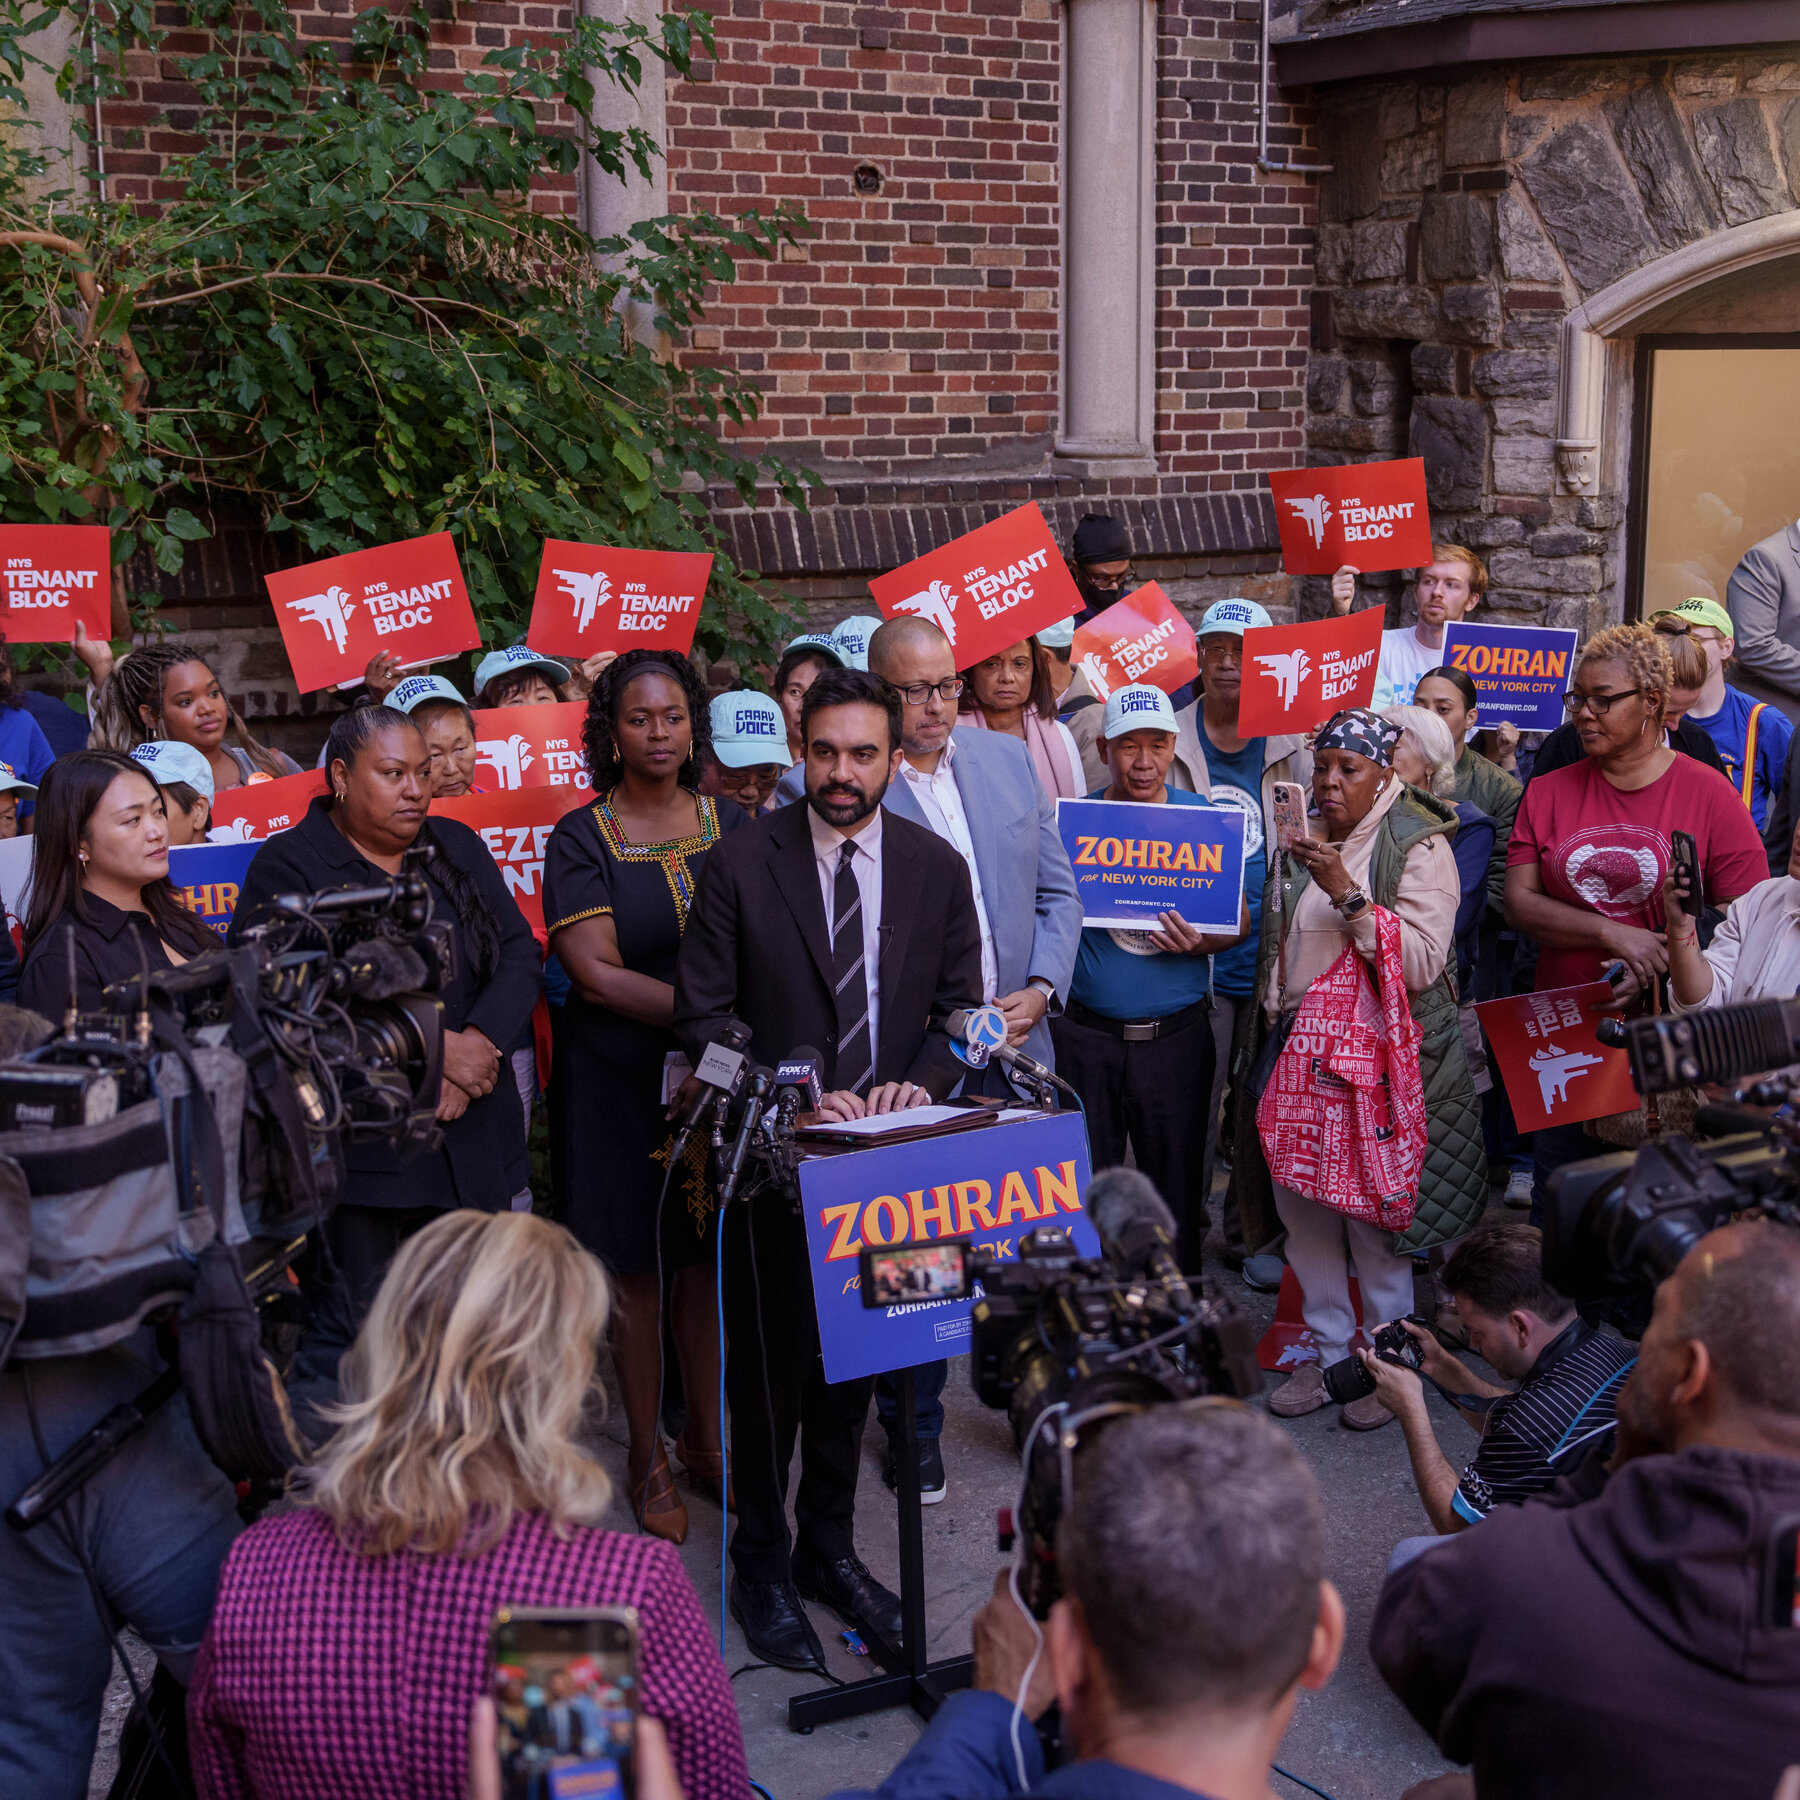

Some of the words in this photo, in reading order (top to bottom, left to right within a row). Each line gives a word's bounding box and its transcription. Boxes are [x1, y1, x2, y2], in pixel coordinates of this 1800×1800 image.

[1341, 498, 1361, 507] NYS
[1339, 502, 1415, 525] TENANT
[1344, 522, 1393, 542] BLOC
[7, 558, 32, 568] NYS
[4, 570, 98, 589] TENANT
[963, 566, 986, 583] NYS
[964, 548, 1048, 603] TENANT
[364, 582, 388, 596] NYS
[625, 582, 646, 593] NYS
[8, 590, 69, 609] BLOC
[363, 579, 452, 616] TENANT
[619, 594, 694, 613] TENANT
[977, 581, 1034, 621] BLOC
[374, 606, 433, 636] BLOC
[618, 614, 667, 631] BLOC
[1215, 611, 1252, 624] VOICE
[1110, 637, 1128, 652] NYS
[1112, 618, 1176, 667] TENANT
[1124, 645, 1169, 681] BLOC
[1319, 649, 1376, 682] TENANT
[1322, 650, 1341, 662] NYS
[1450, 644, 1568, 678] ZOHRAN
[398, 683, 440, 706] VOICE
[1321, 675, 1358, 701] BLOC
[1472, 680, 1499, 691] NEW
[1501, 681, 1530, 693] YORK
[1532, 683, 1557, 693] CITY
[1121, 701, 1160, 715] VOICE
[1475, 702, 1537, 712] HRANFORNYC.COM
[735, 720, 777, 736] VOICE
[545, 739, 569, 750] NYS
[542, 750, 587, 771] TEN
[268, 815, 290, 829] NYS
[480, 825, 555, 862] EZE
[1073, 836, 1224, 874] ZOHRAN
[1079, 873, 1099, 883] FOR
[1102, 873, 1136, 885] NEW
[1139, 875, 1178, 888] YORK
[1181, 877, 1214, 889] CITY
[1114, 899, 1176, 908] ZOHRANFORNYC.COM
[1525, 1020, 1539, 1038] NYS
[971, 1042, 986, 1064] abc
[1283, 1035, 1327, 1055] YOU
[778, 1066, 801, 1074] FOX
[801, 1065, 811, 1073] 5
[1298, 1056, 1309, 1092] everyday
[1273, 1125, 1290, 1176] FEEDING
[1331, 1122, 1342, 1161] LOVE
[1293, 1125, 1321, 1184] LIFE
[1319, 1121, 1332, 1190] EVERYTHING
[1339, 1142, 1350, 1175] MUCH
[1328, 1162, 1341, 1191] YOU
[1378, 1144, 1399, 1192] FEEDING
[1338, 1177, 1349, 1194] SO
[1315, 1189, 1347, 1205] LOVE
[1348, 1195, 1374, 1206] YOU
[820, 1160, 1084, 1263] ZOHRAN
[842, 1275, 861, 1294] FO
